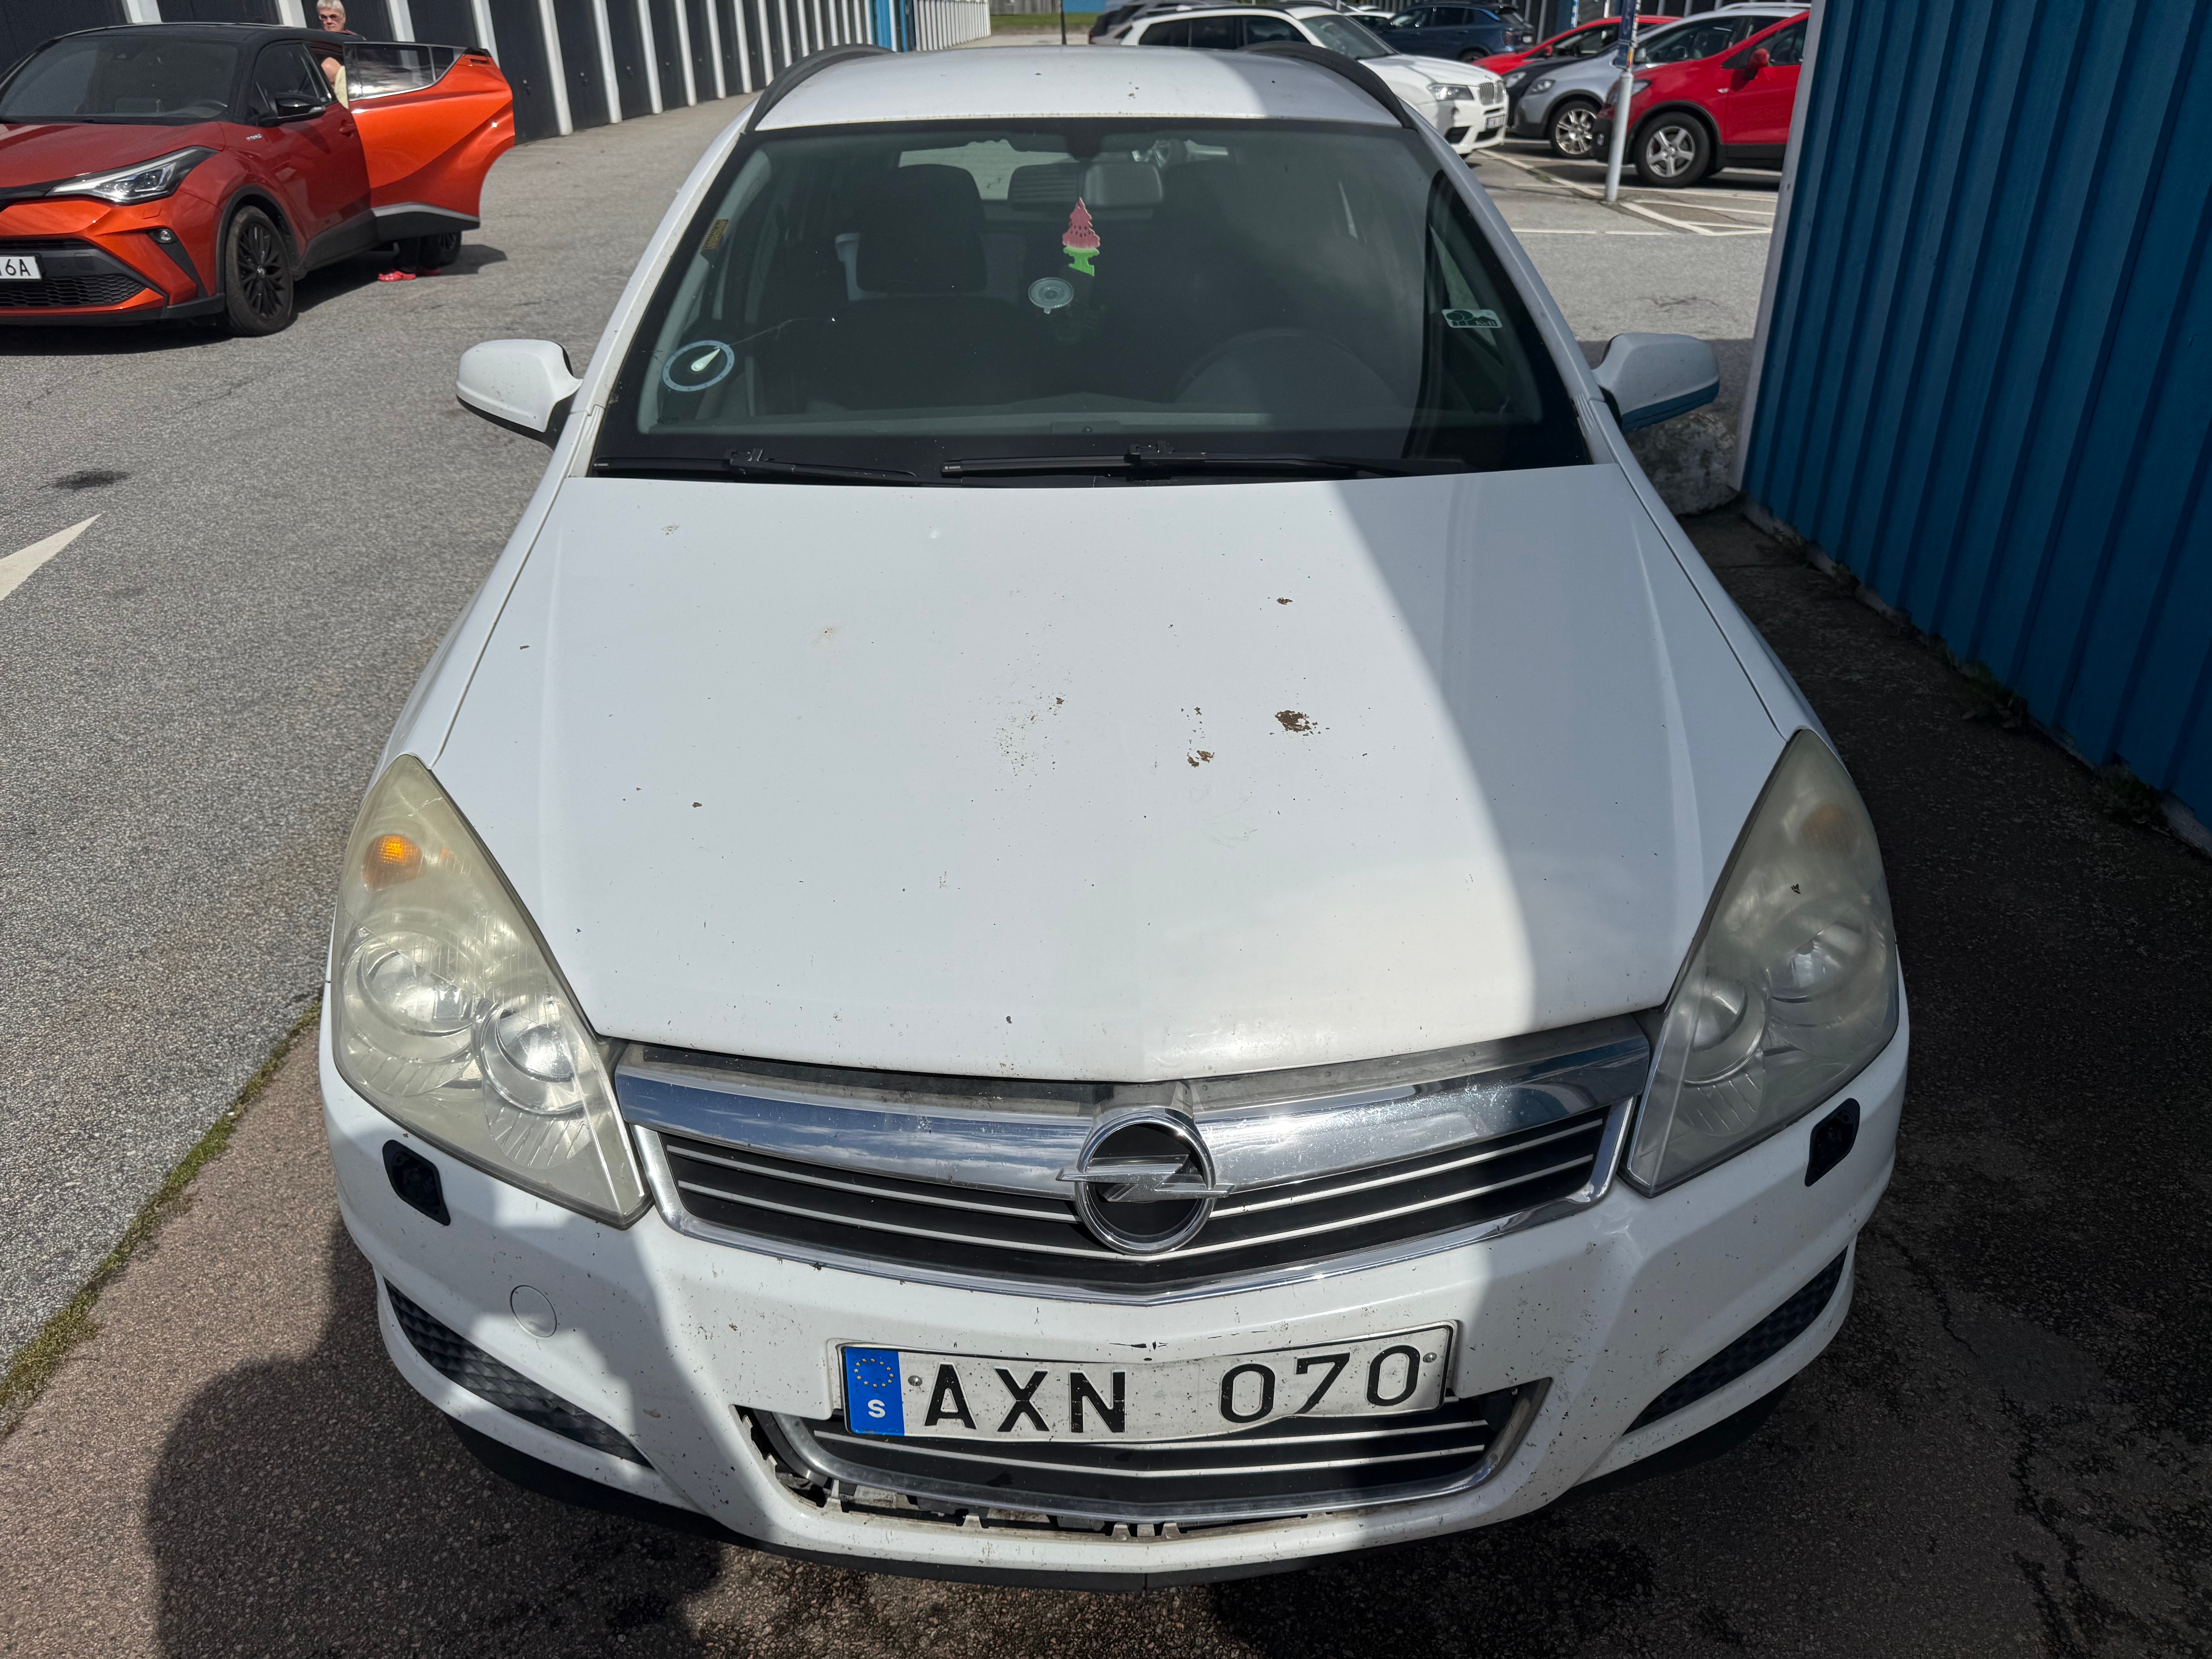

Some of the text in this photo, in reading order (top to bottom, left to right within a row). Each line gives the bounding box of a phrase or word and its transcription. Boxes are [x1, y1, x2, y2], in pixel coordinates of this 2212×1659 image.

[0, 259, 31, 276] 6A
[924, 1345, 1420, 1433] AXN 070
[867, 1399, 886, 1418] S
